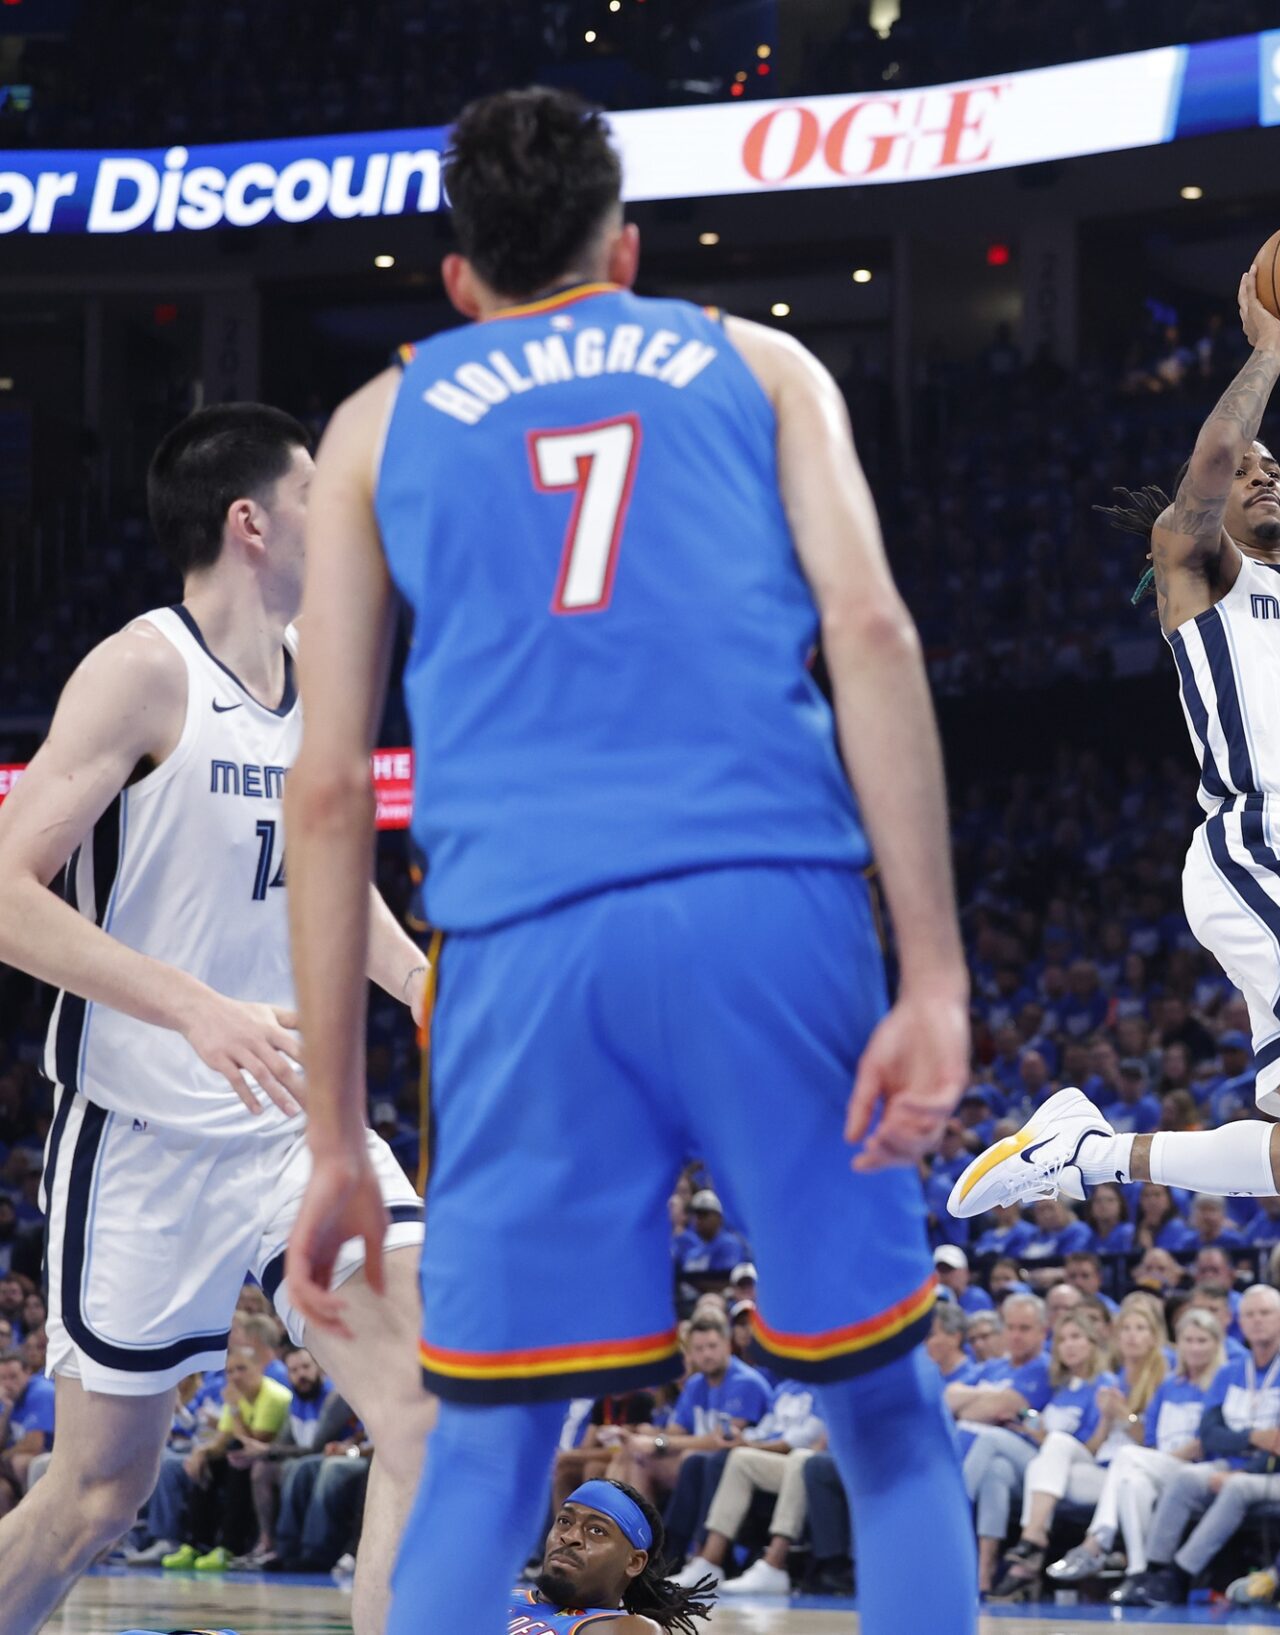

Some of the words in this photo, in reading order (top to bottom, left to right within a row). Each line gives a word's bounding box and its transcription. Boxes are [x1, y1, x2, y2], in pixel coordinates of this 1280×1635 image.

[87, 145, 452, 233] Discoun
[422, 323, 718, 425] HOLMGREN
[526, 413, 642, 615] 7
